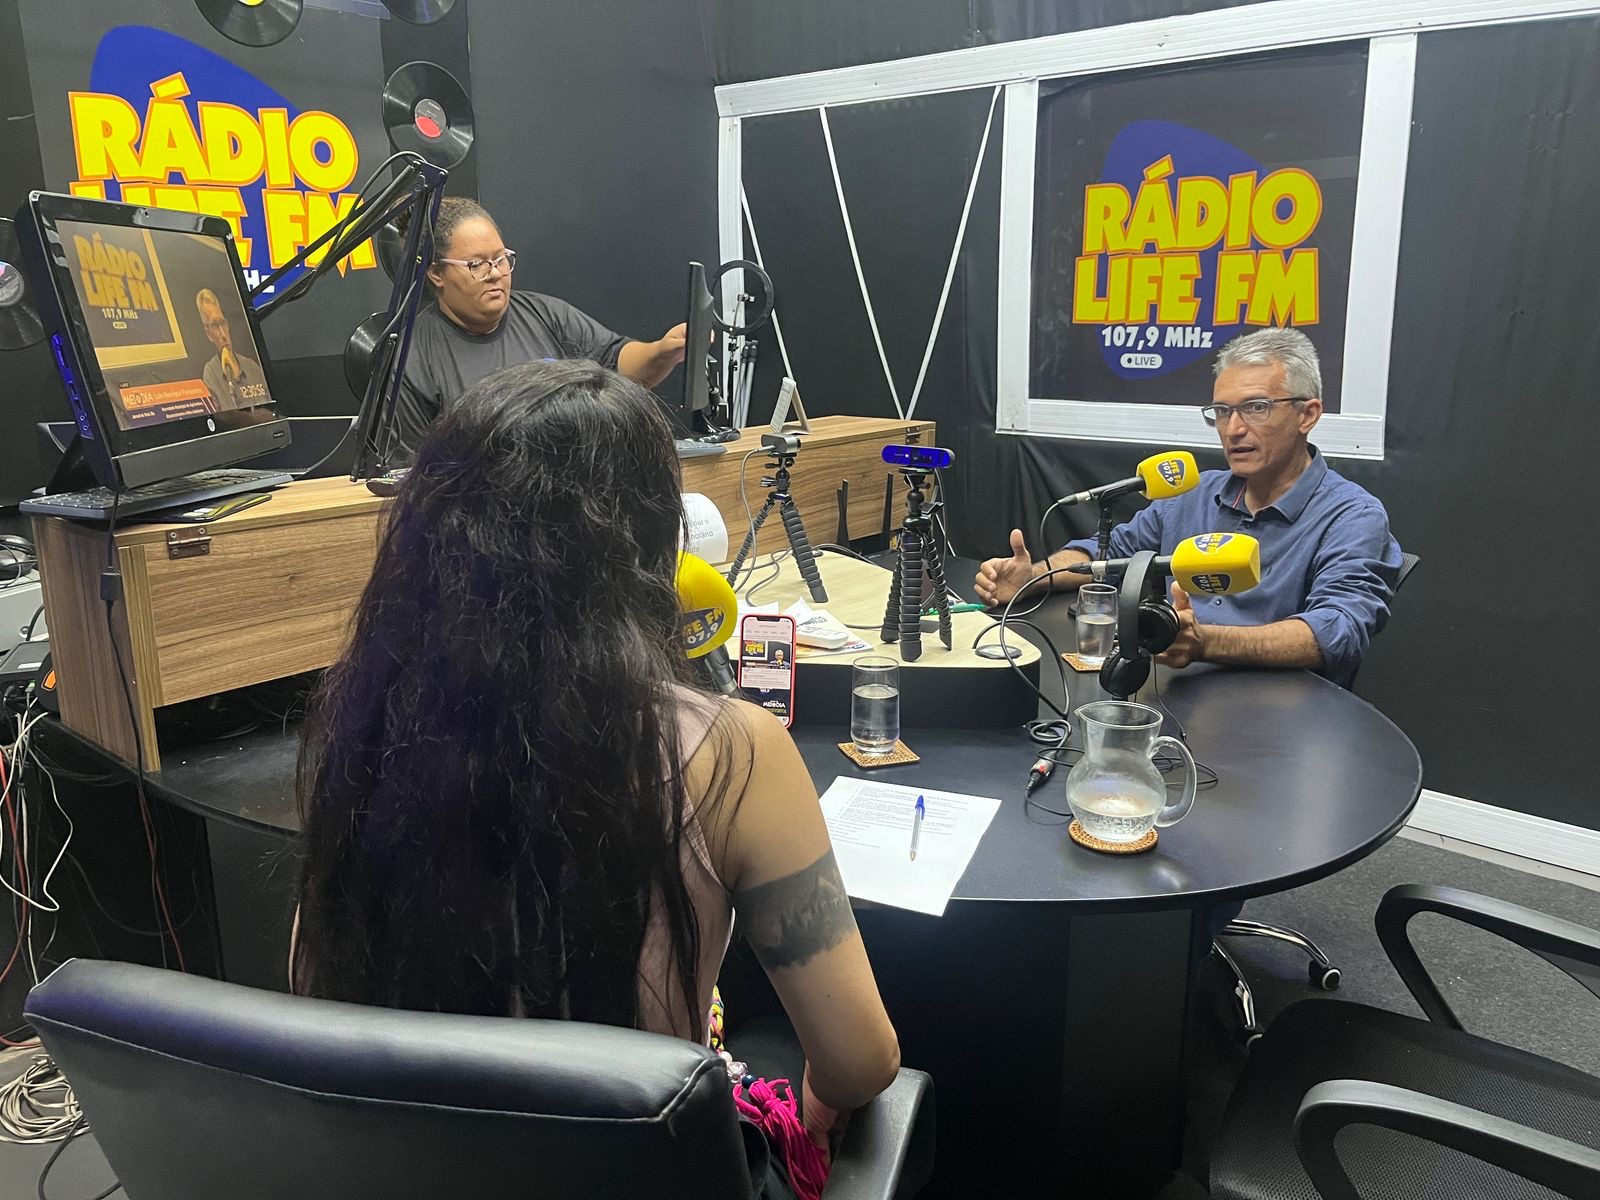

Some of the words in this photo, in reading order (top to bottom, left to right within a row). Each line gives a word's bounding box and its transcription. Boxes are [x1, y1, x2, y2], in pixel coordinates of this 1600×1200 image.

[67, 72, 359, 192] RÁDIO
[1082, 154, 1323, 255] RÁDIO
[73, 231, 146, 280] RÁDIO
[80, 271, 130, 309] LIFE
[127, 277, 159, 312] FM
[242, 269, 275, 293] Hz
[1072, 252, 1201, 325] LIFE
[1212, 247, 1320, 329] FM
[102, 308, 122, 320] 107,9
[1101, 326, 1159, 350] 107,9
[1164, 326, 1213, 349] MHz
[1134, 356, 1156, 366] LIVE
[1161, 460, 1174, 482] 107,9
[687, 622, 719, 644] 07,9
